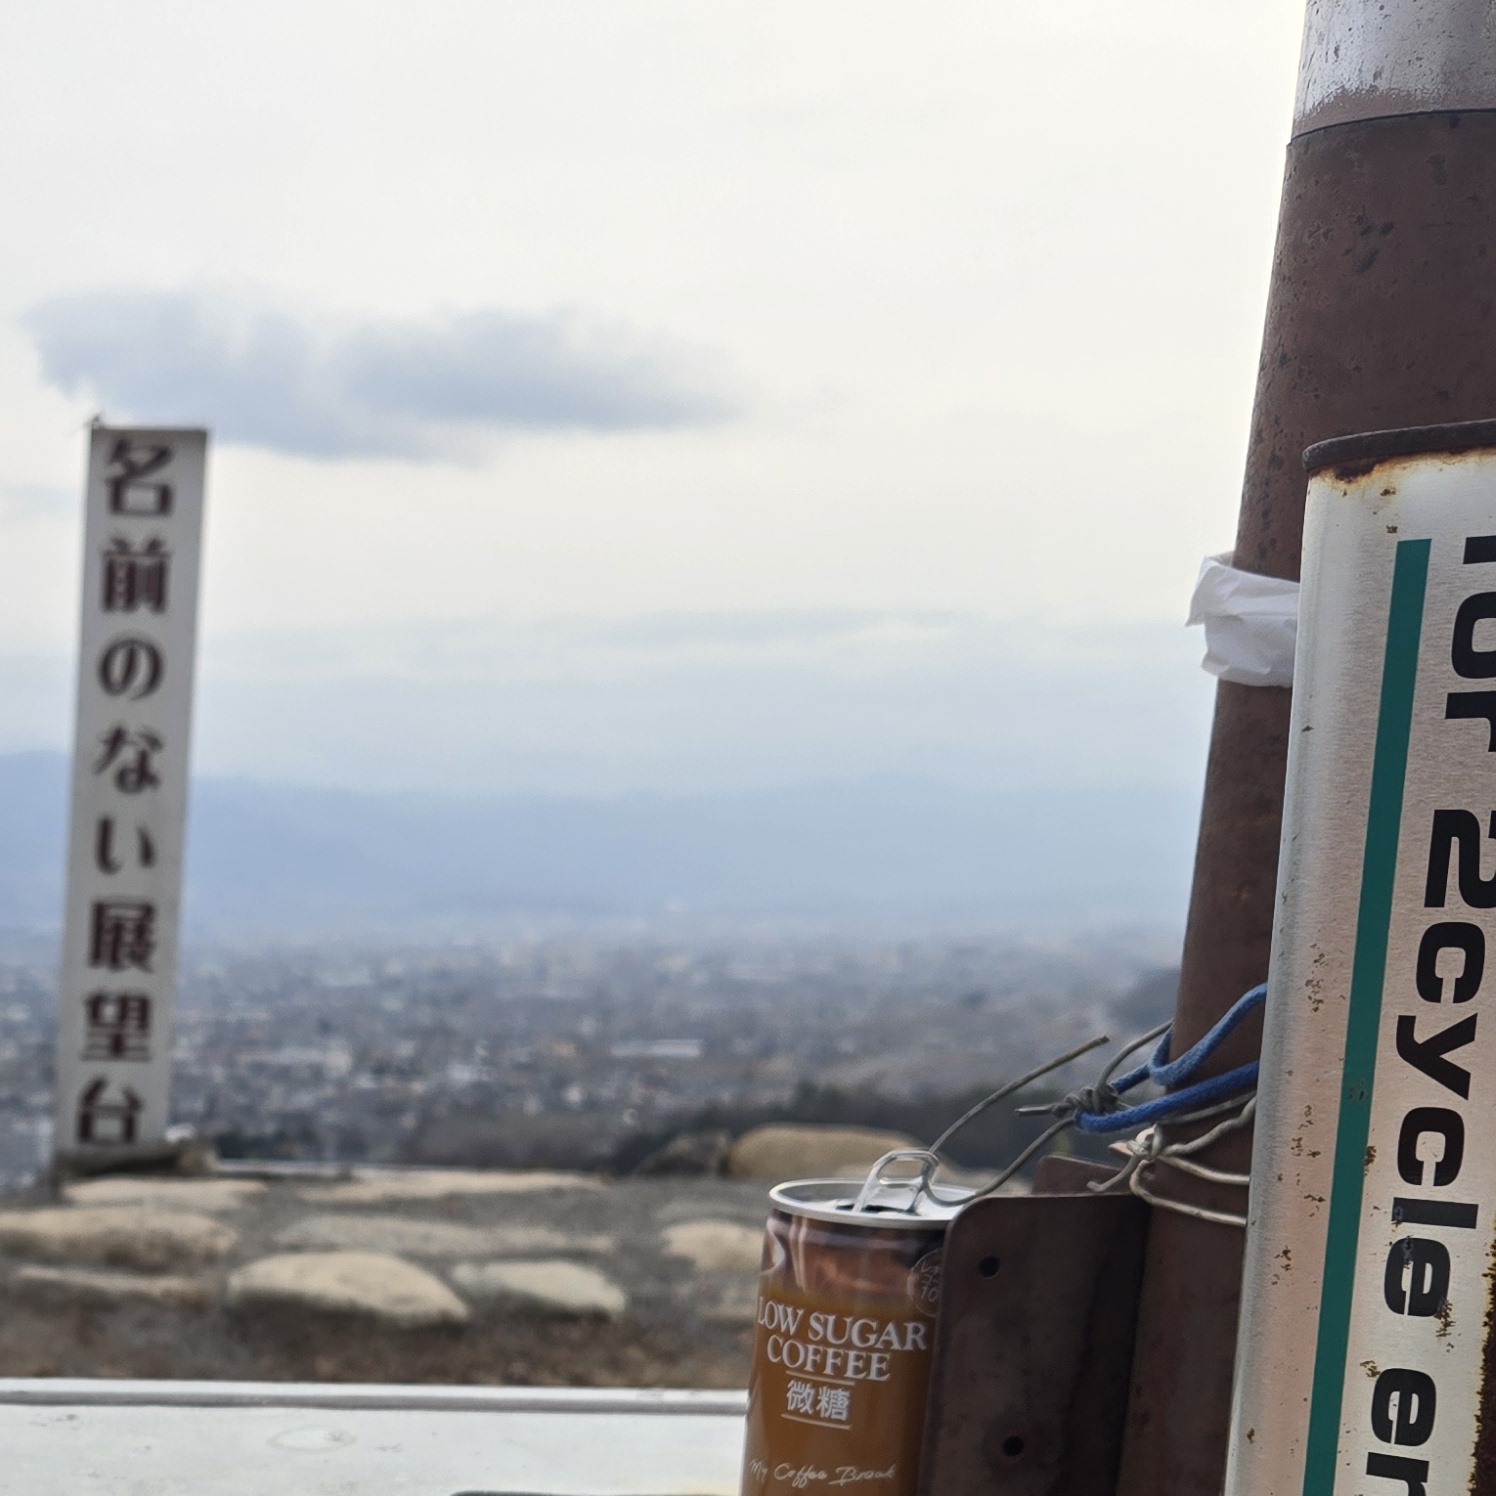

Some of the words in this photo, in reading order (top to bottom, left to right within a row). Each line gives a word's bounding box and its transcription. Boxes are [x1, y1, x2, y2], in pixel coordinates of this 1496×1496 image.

[74, 437, 176, 1146] 名前のない展望台
[757, 1296, 805, 1336] LOW
[808, 1311, 928, 1351] SUGAR
[766, 1334, 892, 1382] COFFEE
[786, 1379, 852, 1421] 微糖
[773, 1462, 828, 1489] Coffee
[828, 1463, 898, 1487] Break
